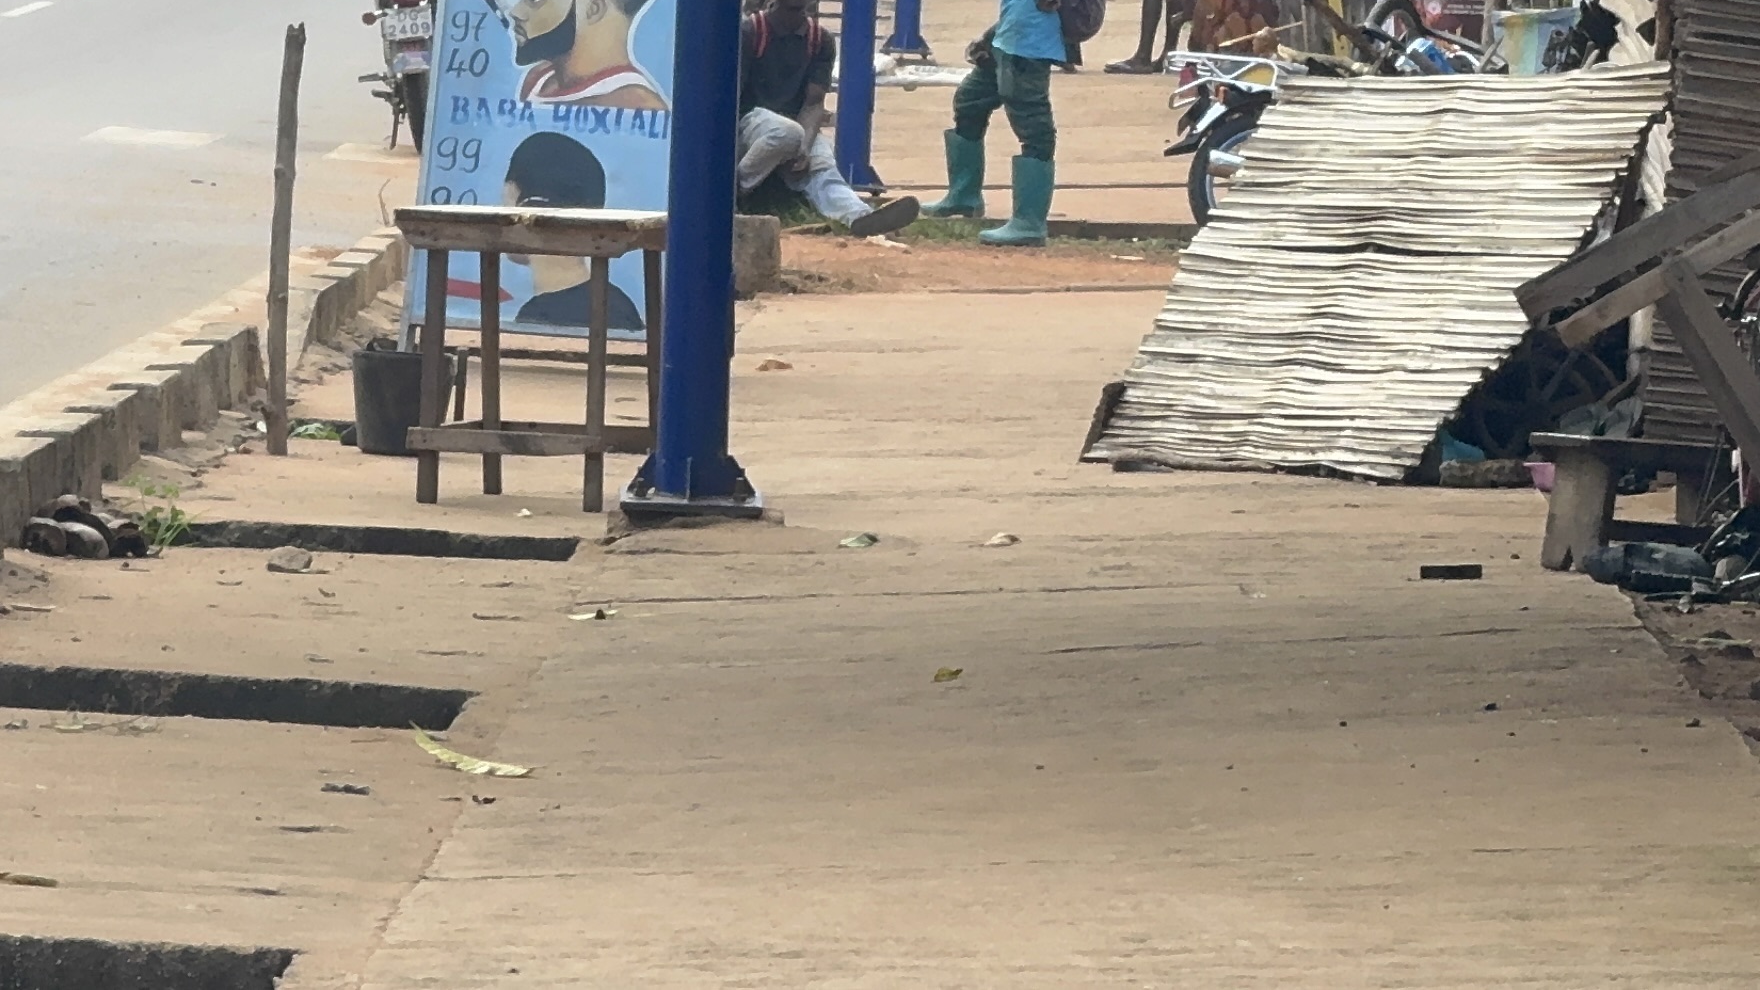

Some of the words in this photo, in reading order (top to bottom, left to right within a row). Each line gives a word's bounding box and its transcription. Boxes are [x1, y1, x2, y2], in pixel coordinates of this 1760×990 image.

[388, 22, 431, 37] 2409
[451, 10, 488, 43] 97
[446, 48, 490, 79] 40
